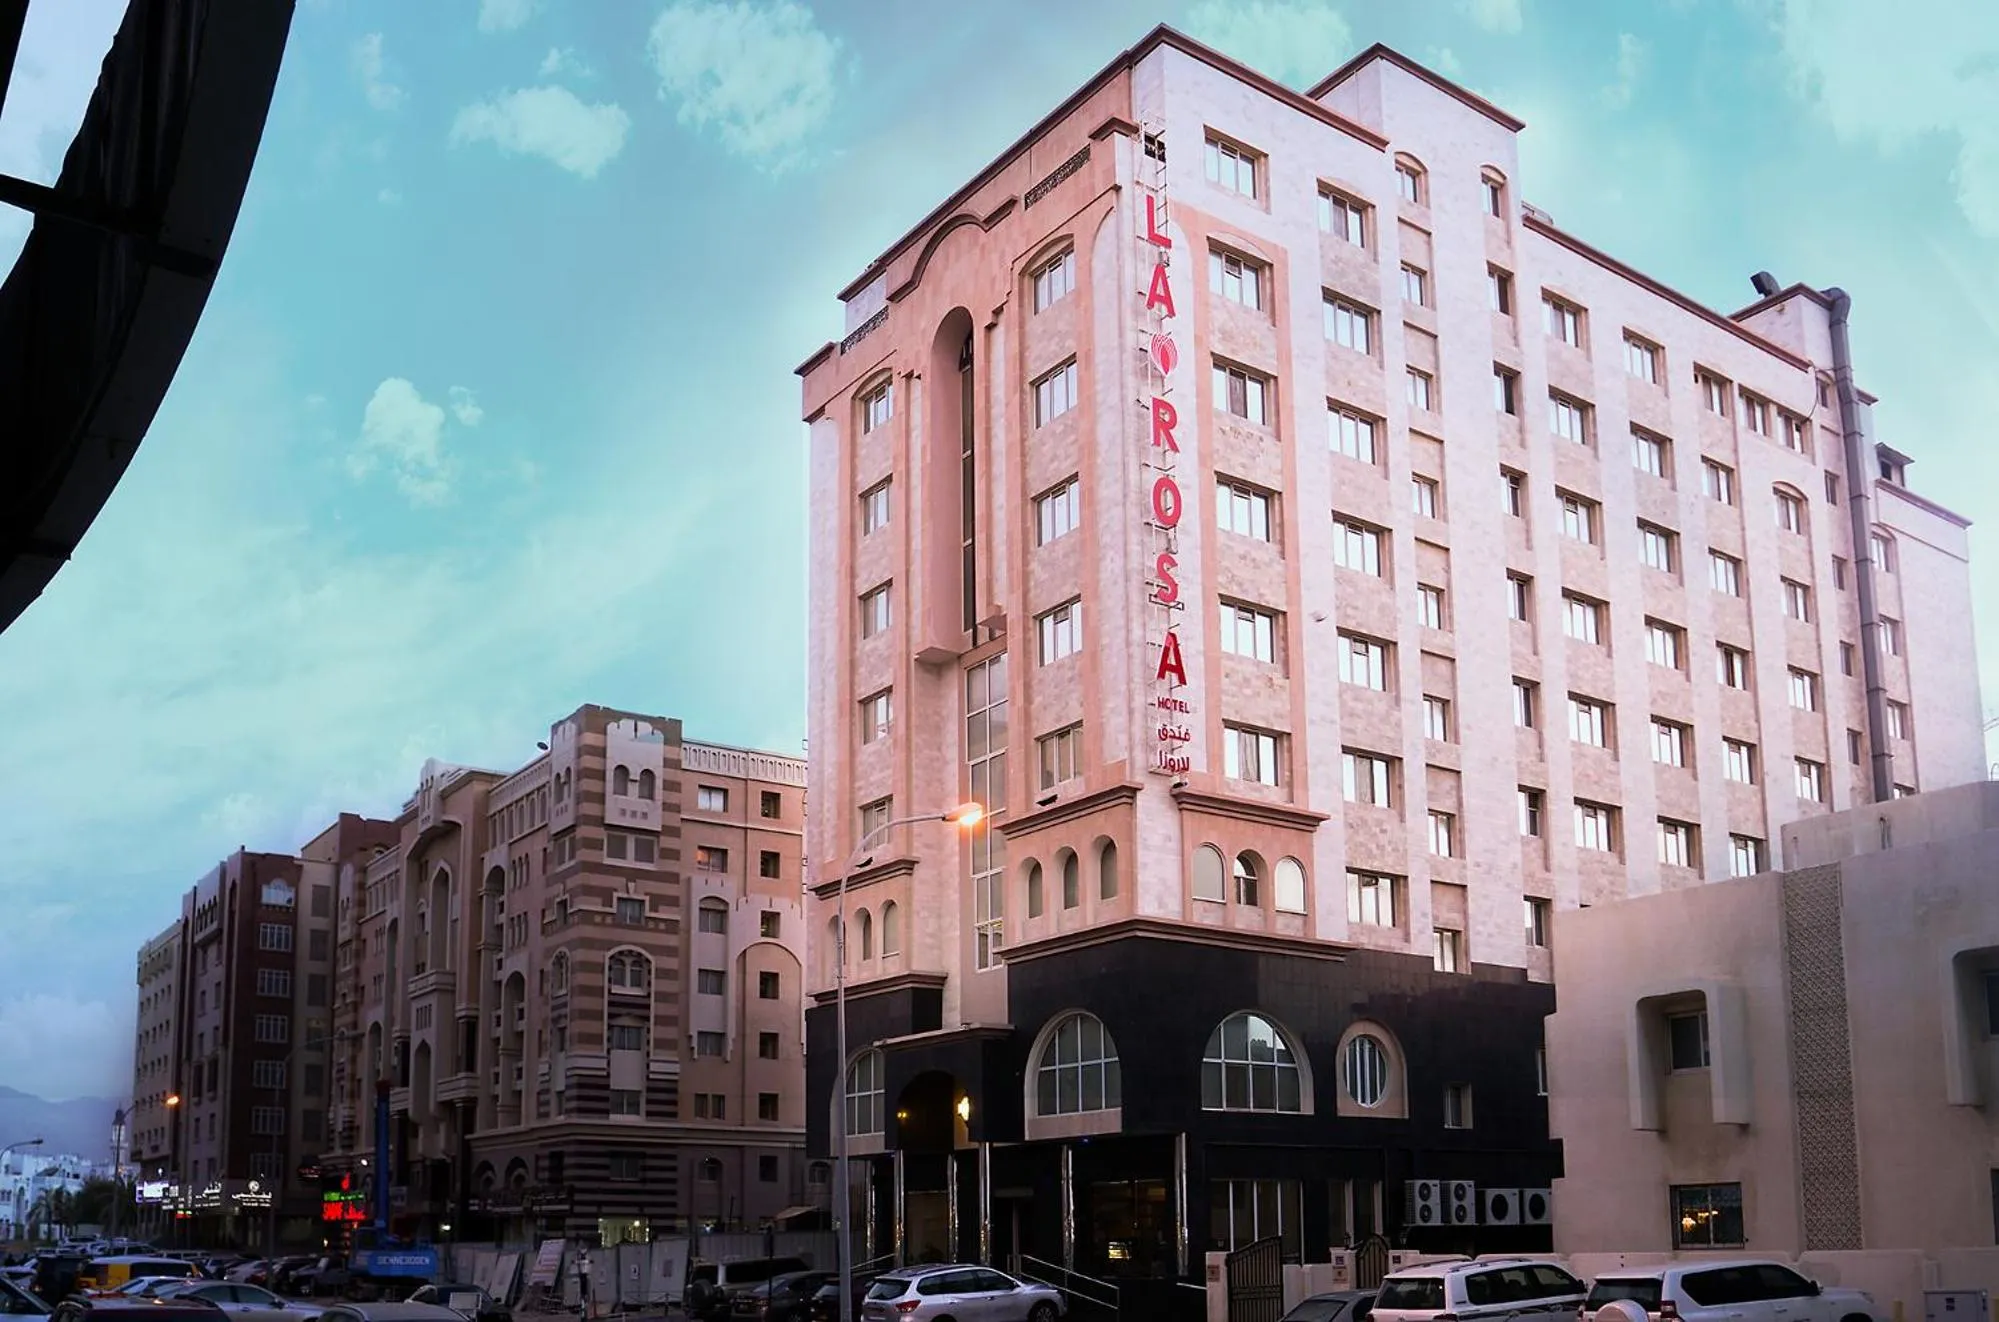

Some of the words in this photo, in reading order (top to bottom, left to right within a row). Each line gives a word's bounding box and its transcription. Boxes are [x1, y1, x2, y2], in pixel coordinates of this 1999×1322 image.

[1157, 696, 1190, 714] HOTEL
[1158, 724, 1191, 742] فندق
[1158, 750, 1190, 773] لاروزا
